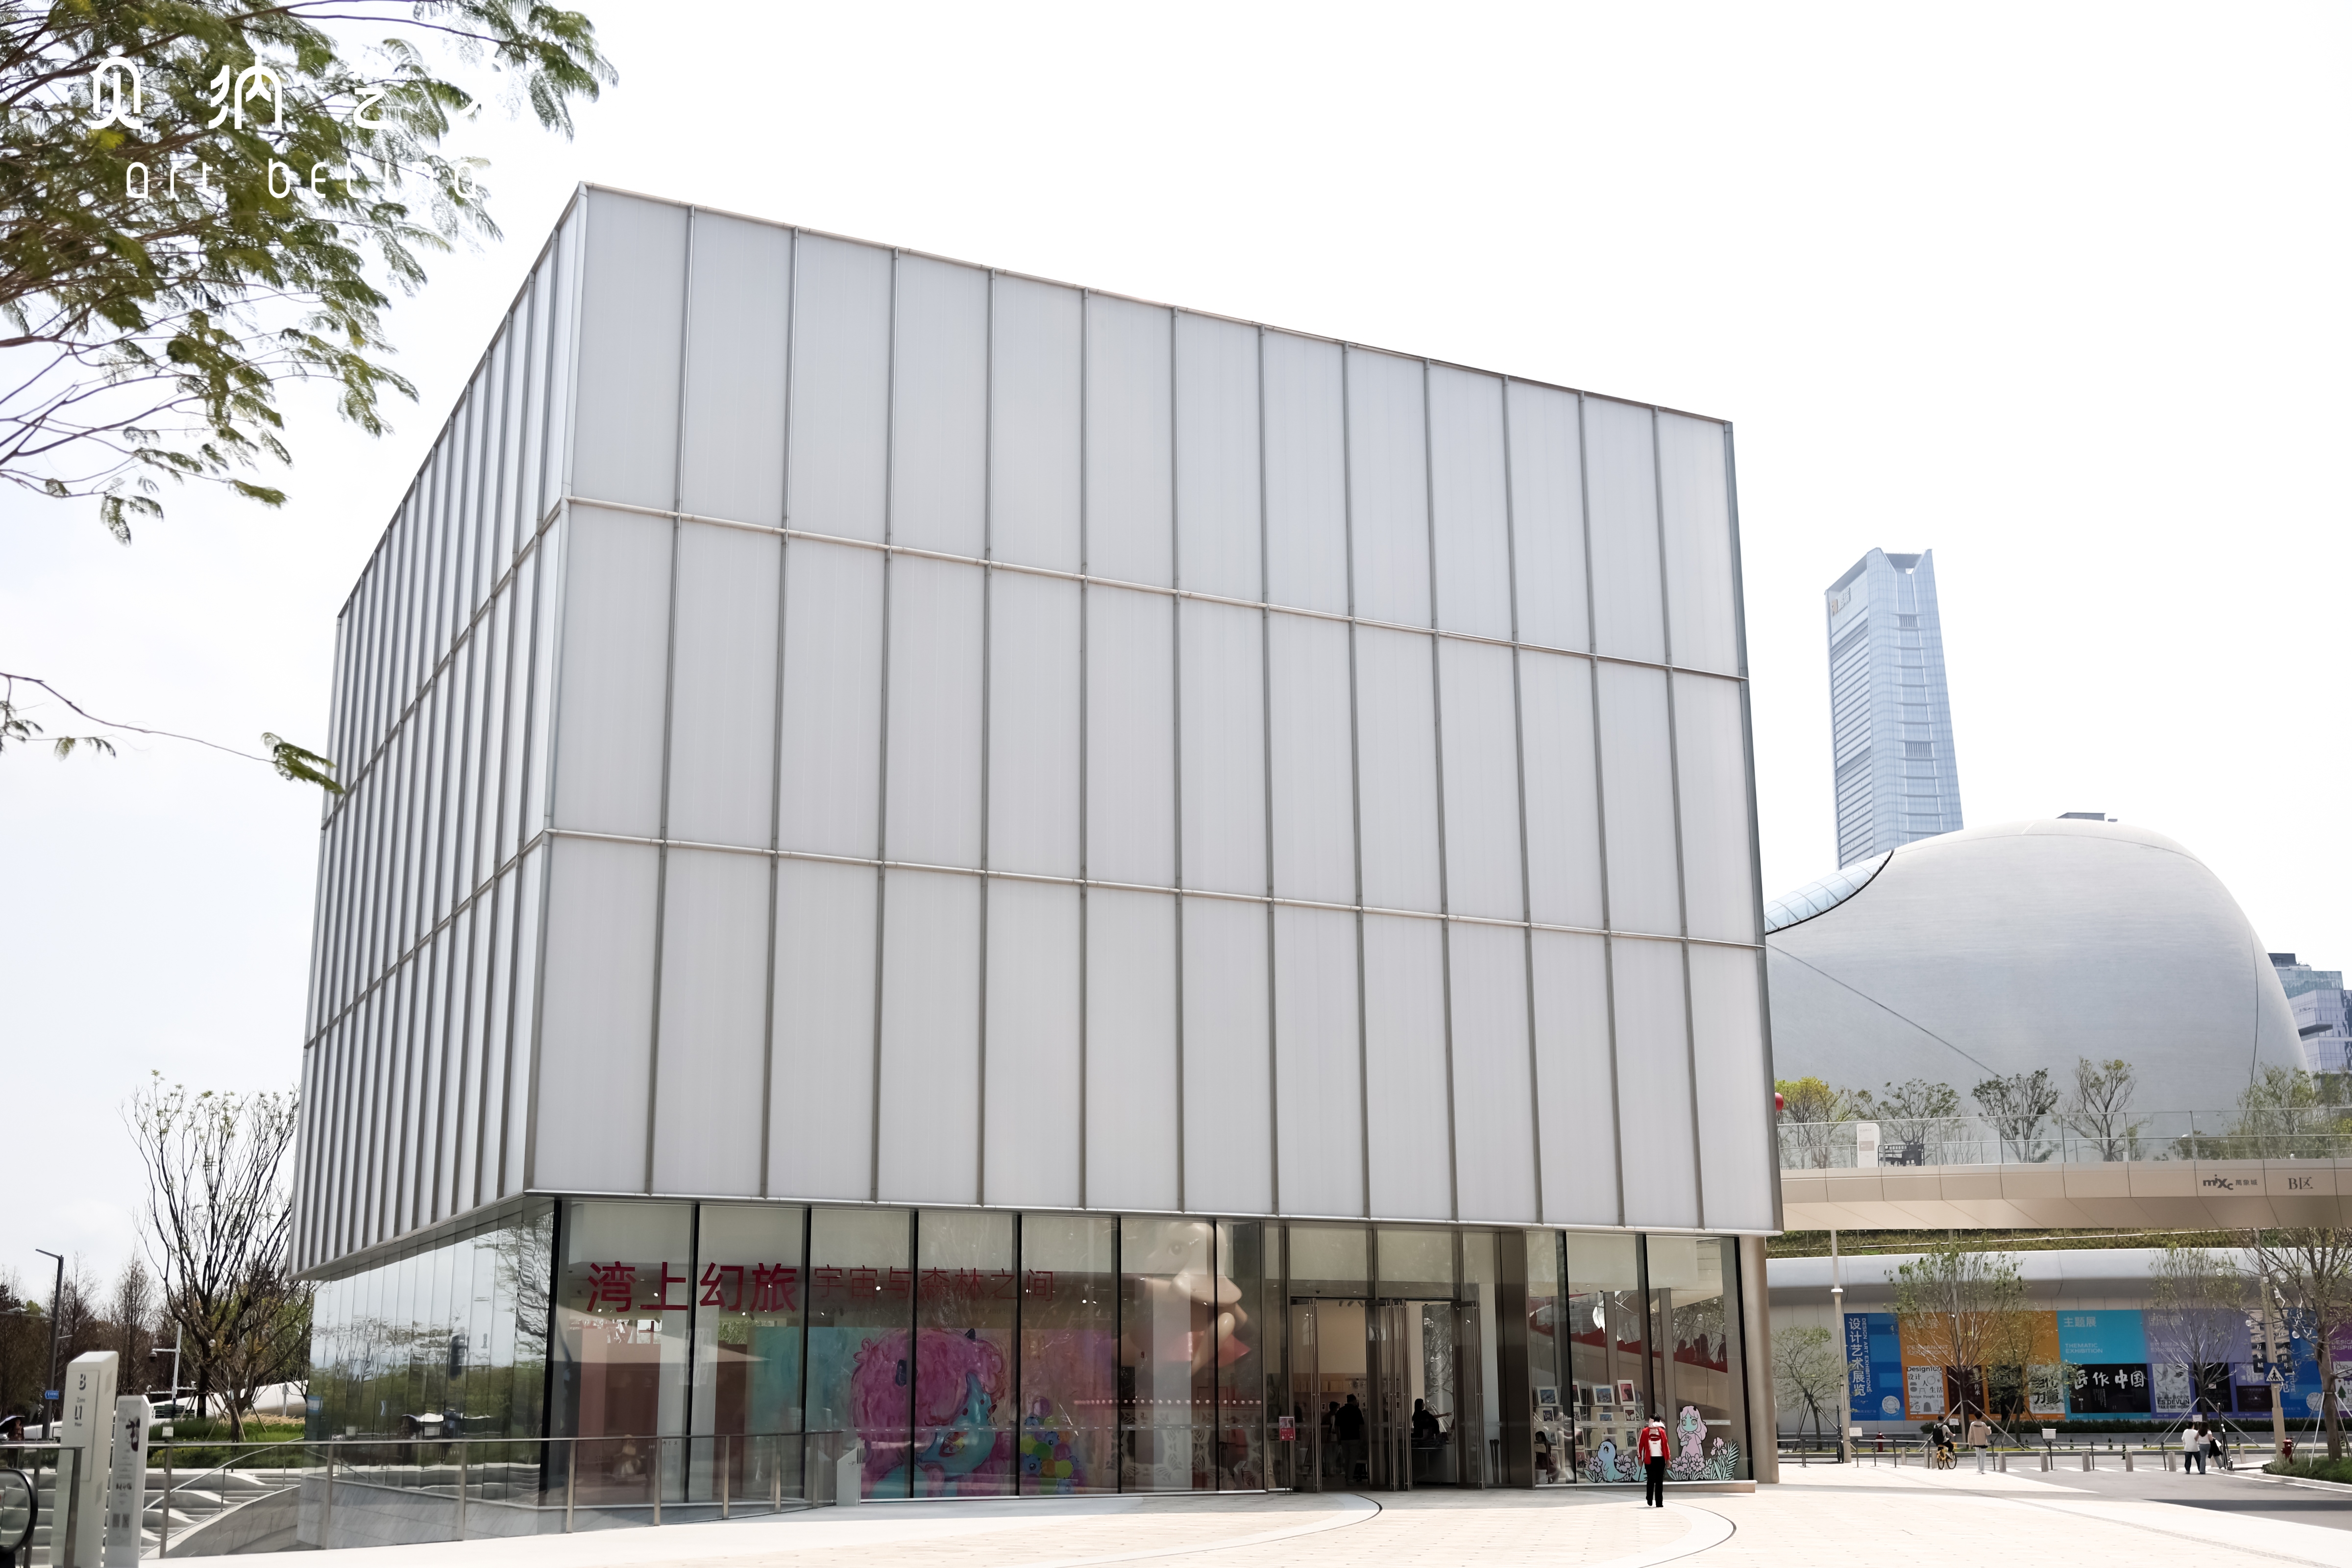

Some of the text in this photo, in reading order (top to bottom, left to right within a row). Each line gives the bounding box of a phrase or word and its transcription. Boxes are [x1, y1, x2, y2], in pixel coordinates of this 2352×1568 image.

[2287, 1176, 2314, 1190] B区
[586, 1261, 797, 1313] 湾上幻旅
[813, 1264, 1054, 1302] 宇宙与森林之间
[2063, 1317, 2097, 1327] 主题展
[1849, 1318, 1866, 1397] 设计艺术展览
[79, 1373, 87, 1391] B
